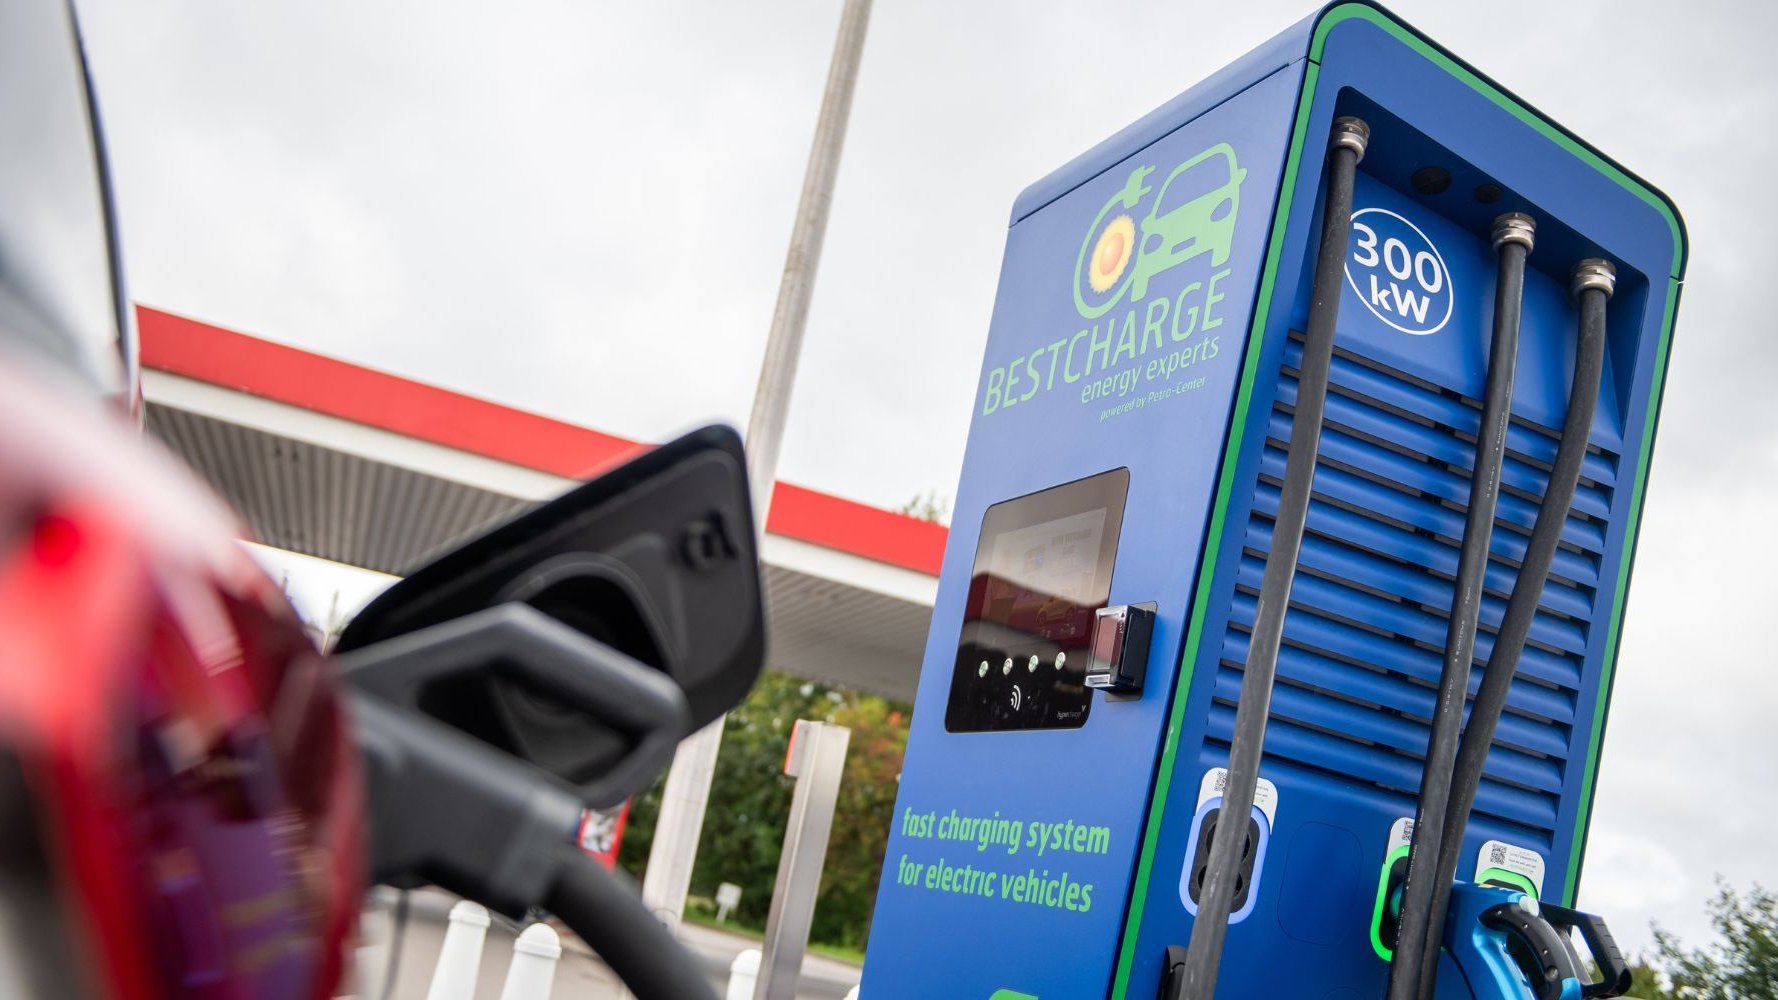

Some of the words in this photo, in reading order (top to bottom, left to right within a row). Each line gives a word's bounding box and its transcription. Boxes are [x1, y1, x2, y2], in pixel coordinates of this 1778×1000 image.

[1353, 222, 1442, 293] 300
[1370, 274, 1430, 324] kW
[982, 267, 1232, 416] BESTCHARGE
[1081, 365, 1143, 404] energy
[1146, 334, 1220, 381] experts
[1099, 399, 1135, 424] powered
[1135, 396, 1147, 409] by
[1148, 376, 1206, 402] Petro-Center
[902, 806, 936, 839] fast
[937, 809, 1023, 855] charging
[1026, 819, 1111, 857] system
[897, 854, 923, 887] for
[925, 858, 997, 898] electric
[1001, 869, 1093, 913] vehicles
